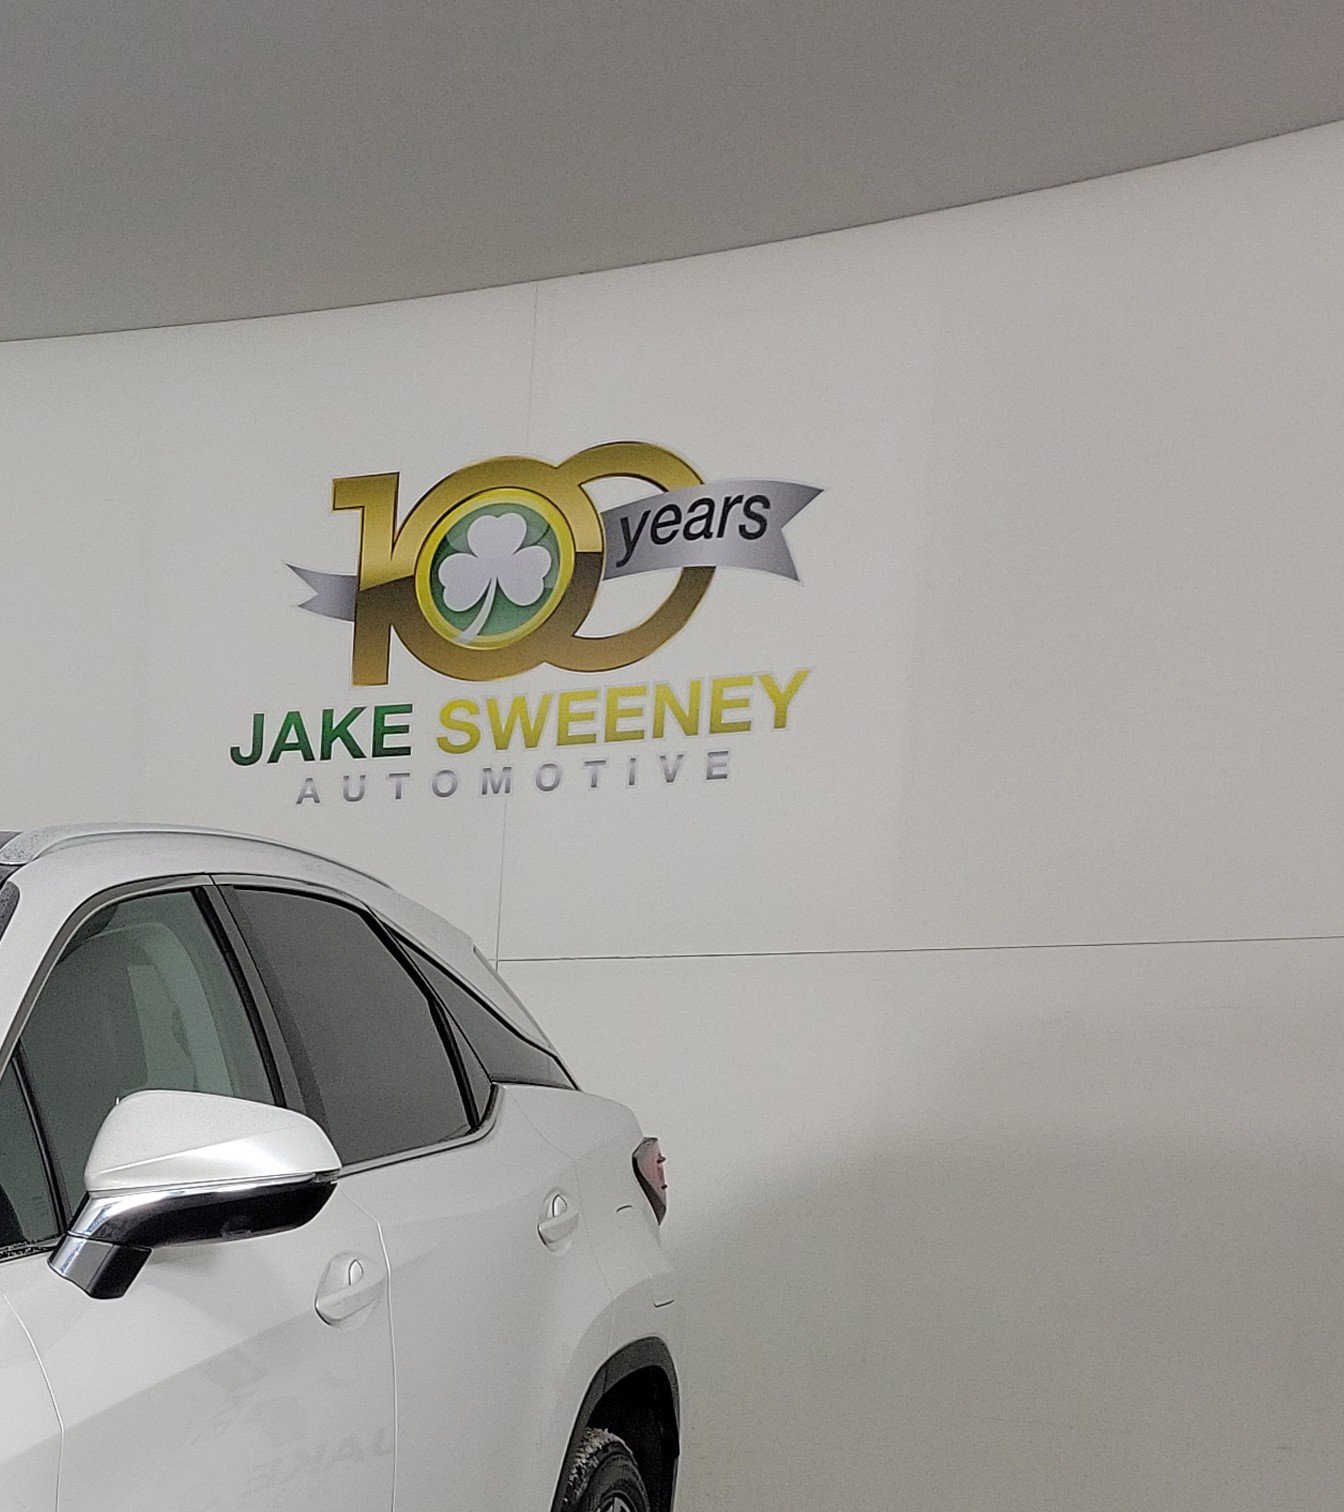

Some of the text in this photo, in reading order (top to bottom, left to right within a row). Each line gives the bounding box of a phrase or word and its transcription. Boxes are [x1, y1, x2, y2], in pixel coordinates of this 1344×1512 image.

[332, 441, 770, 686] 100 years
[230, 670, 810, 766] JAKE SWEENEY
[296, 752, 729, 805] AUTOMOTIVE
